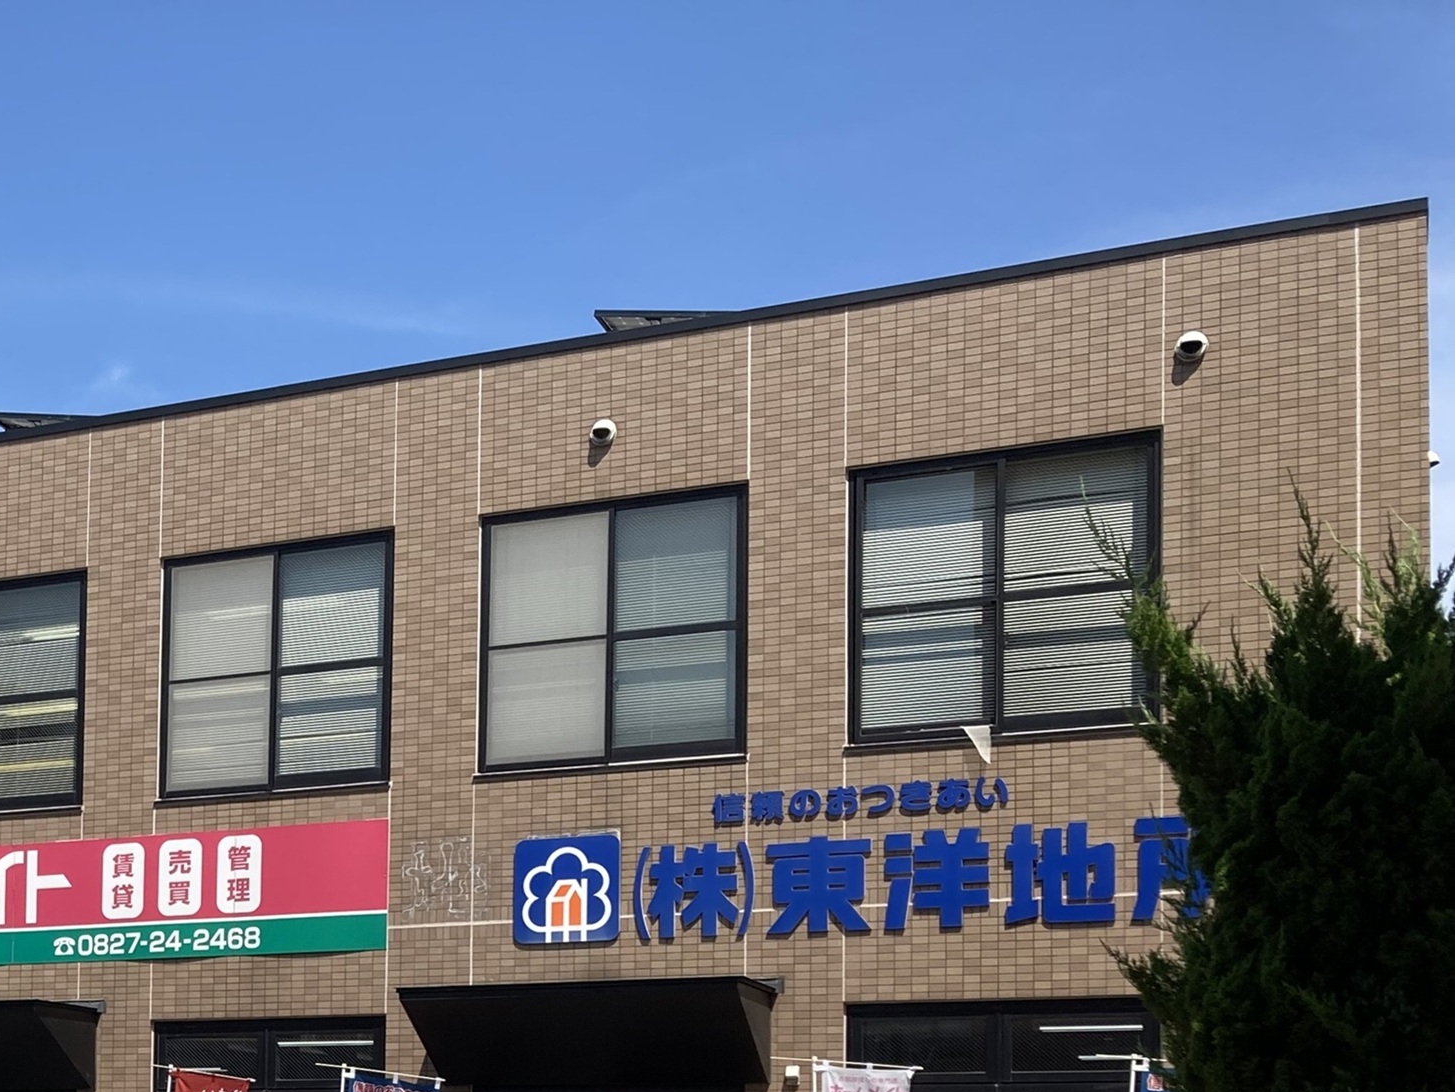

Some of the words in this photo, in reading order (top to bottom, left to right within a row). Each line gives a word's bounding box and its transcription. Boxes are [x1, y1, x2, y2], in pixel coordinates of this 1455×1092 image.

[712, 776, 1009, 823] 信頼のおつきあい
[111, 852, 134, 909] 賃貸
[168, 849, 192, 906] 売買
[227, 845, 251, 902] 管理
[77, 926, 261, 957] 0827-24-2468
